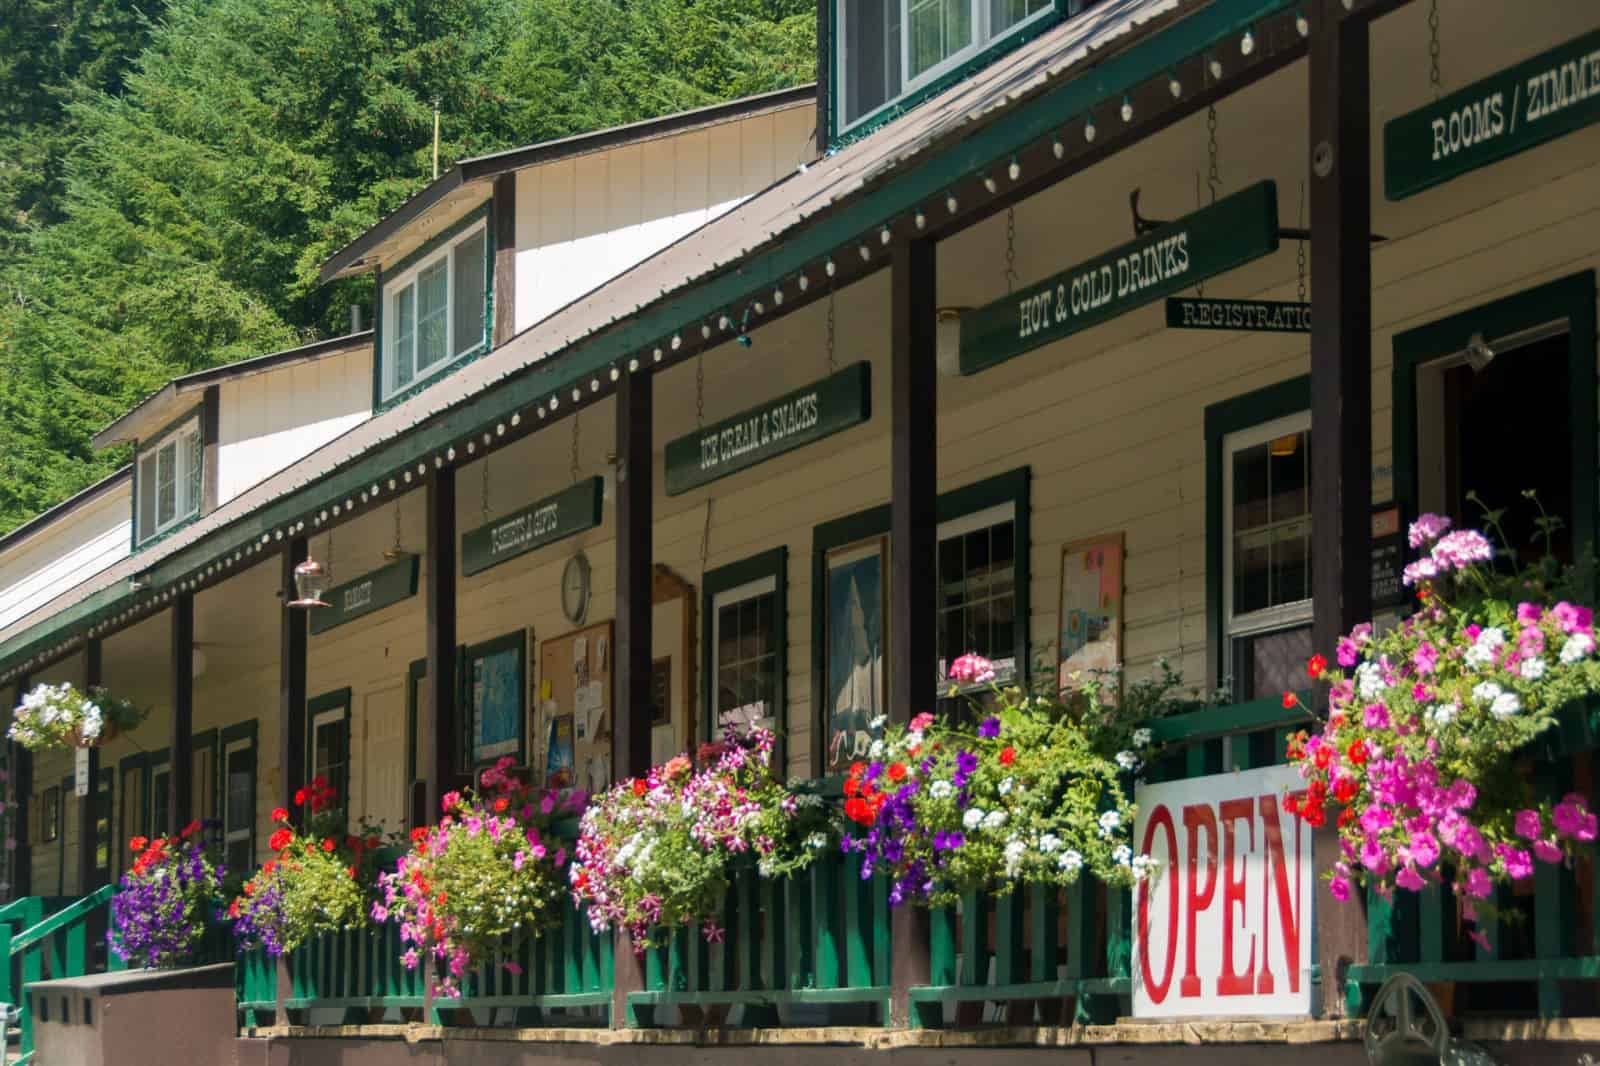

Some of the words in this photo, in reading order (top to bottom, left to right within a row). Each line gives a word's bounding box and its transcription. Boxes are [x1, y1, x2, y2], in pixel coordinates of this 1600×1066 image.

[1432, 92, 1504, 160] ROOMS
[1019, 291, 1051, 338] HOT
[1055, 284, 1067, 322] &
[1071, 266, 1113, 316] COLD
[1117, 232, 1189, 297] DRINKS
[701, 433, 718, 470] ICE
[720, 416, 759, 461] CREAM
[761, 411, 771, 445] &
[772, 392, 817, 440] SNACKS
[1138, 790, 1308, 1005] OPEN
